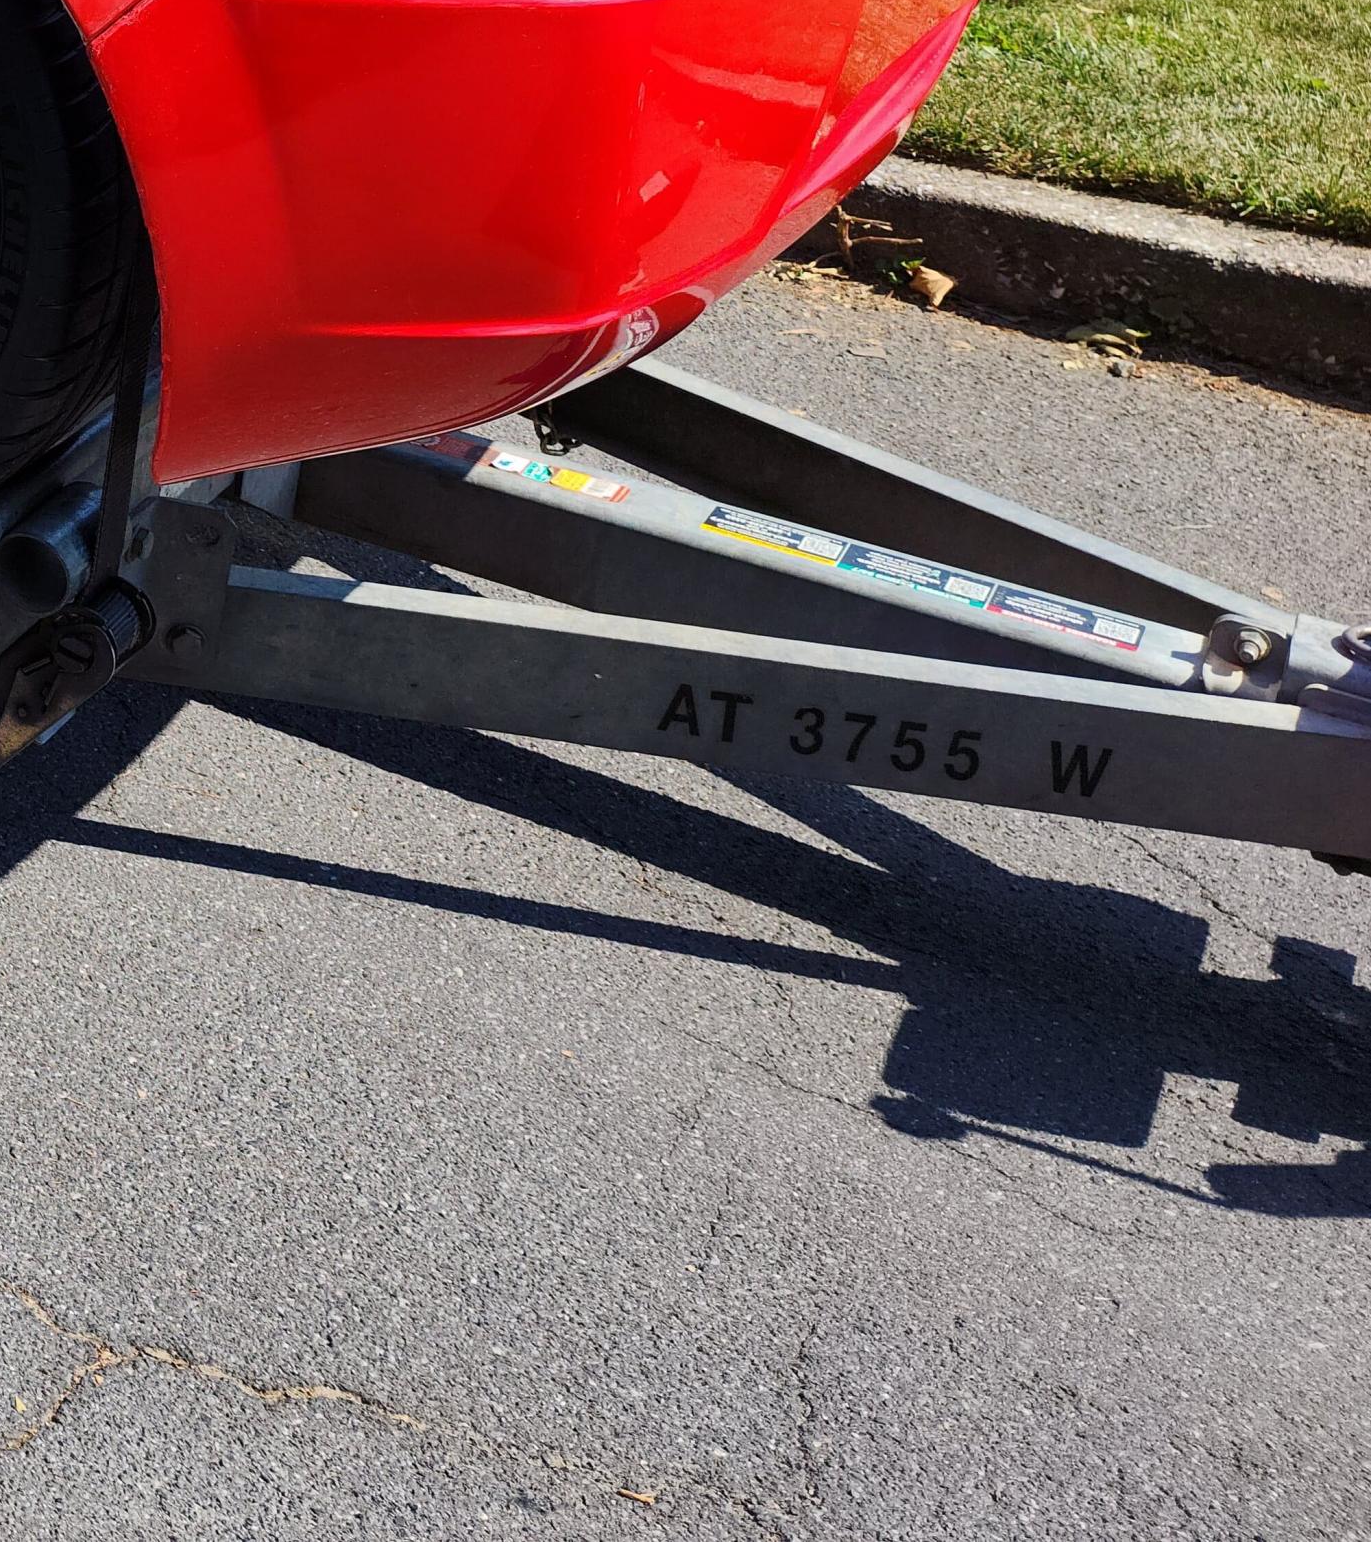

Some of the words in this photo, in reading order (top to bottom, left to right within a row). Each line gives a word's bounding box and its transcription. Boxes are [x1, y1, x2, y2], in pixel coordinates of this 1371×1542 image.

[657, 683, 755, 744] AT
[789, 707, 982, 782] 3755
[1050, 740, 1114, 798] W
